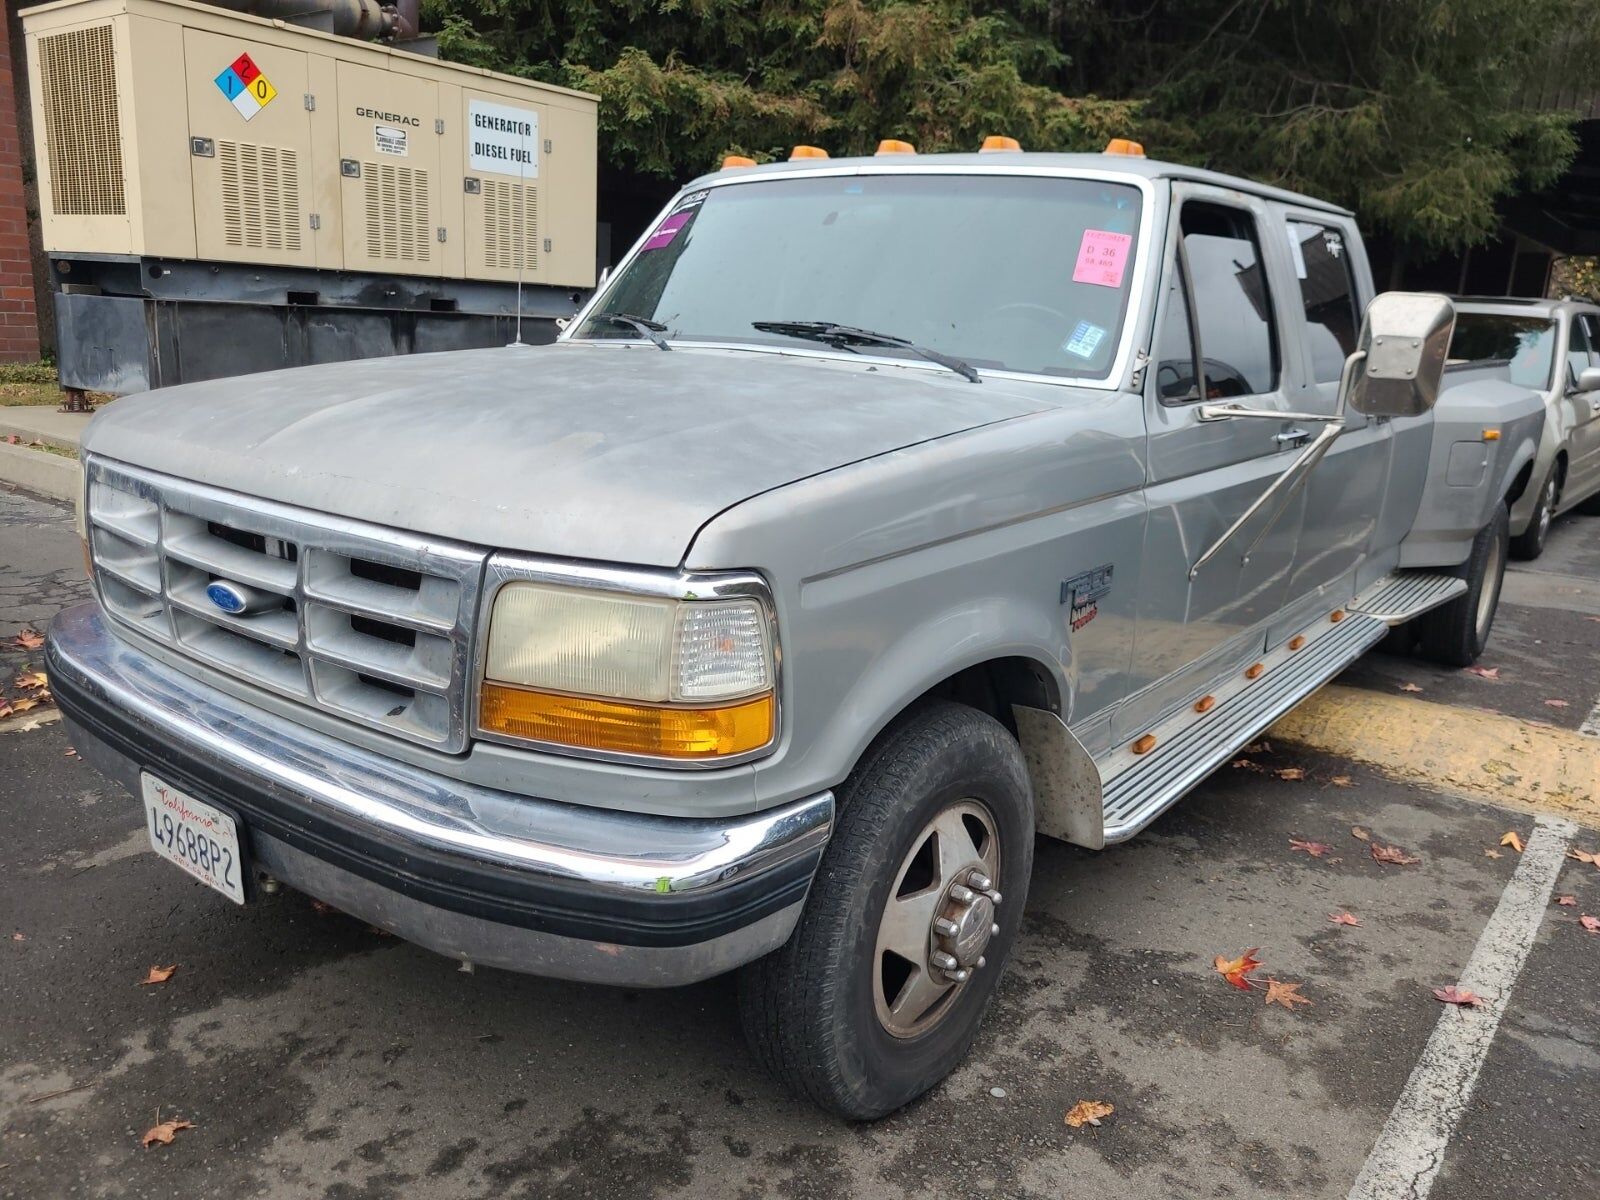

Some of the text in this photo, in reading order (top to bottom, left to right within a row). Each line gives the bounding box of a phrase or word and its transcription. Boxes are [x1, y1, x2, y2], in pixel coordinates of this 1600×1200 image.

[241, 60, 251, 79] 2
[227, 75, 233, 94] 1
[256, 79, 267, 99] 0
[355, 107, 420, 127] GENERAC
[475, 113, 531, 136] GENERATOR
[475, 142, 532, 164] DIESEL FUEL
[1102, 248, 1115, 257] 36
[157, 788, 220, 834] California
[152, 806, 236, 889] 49688P2
